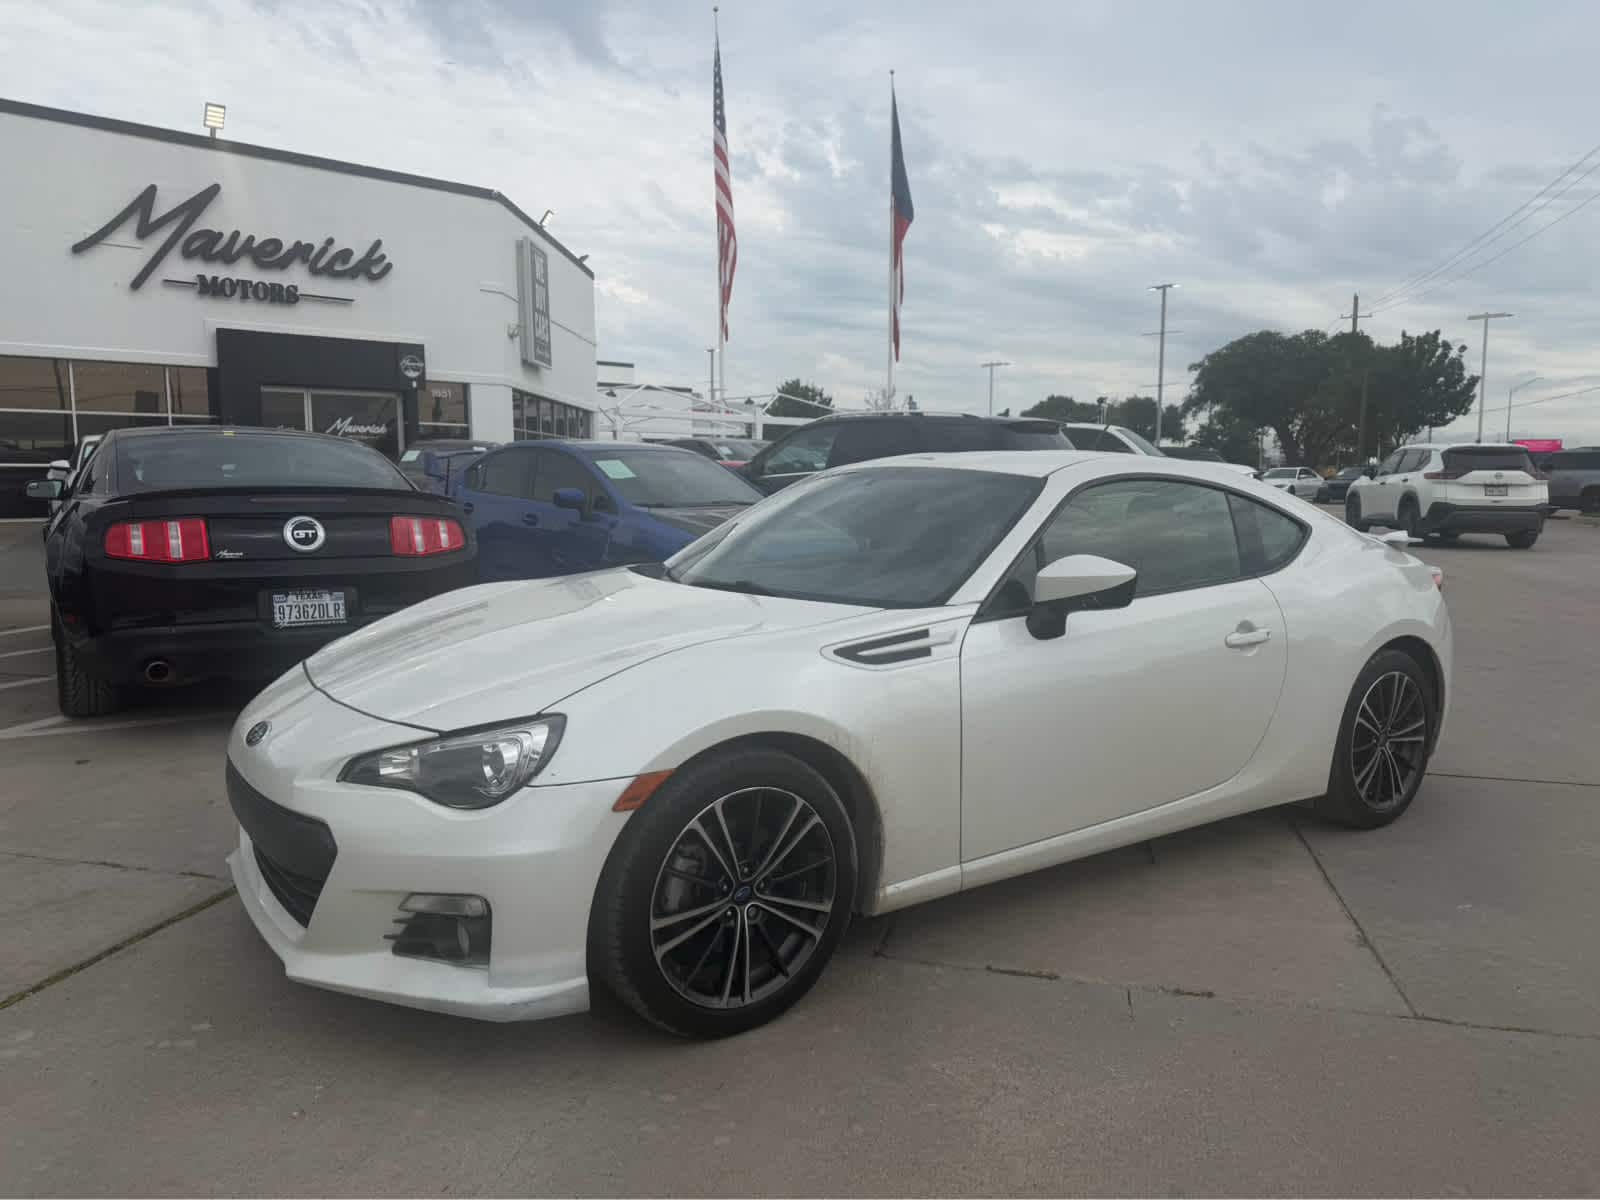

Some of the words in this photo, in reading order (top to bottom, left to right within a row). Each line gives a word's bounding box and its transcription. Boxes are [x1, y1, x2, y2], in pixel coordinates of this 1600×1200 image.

[71, 183, 393, 290] Maverick
[197, 274, 300, 304] MOTORS
[293, 529, 316, 539] GT
[278, 602, 341, 620] 97362DLR
